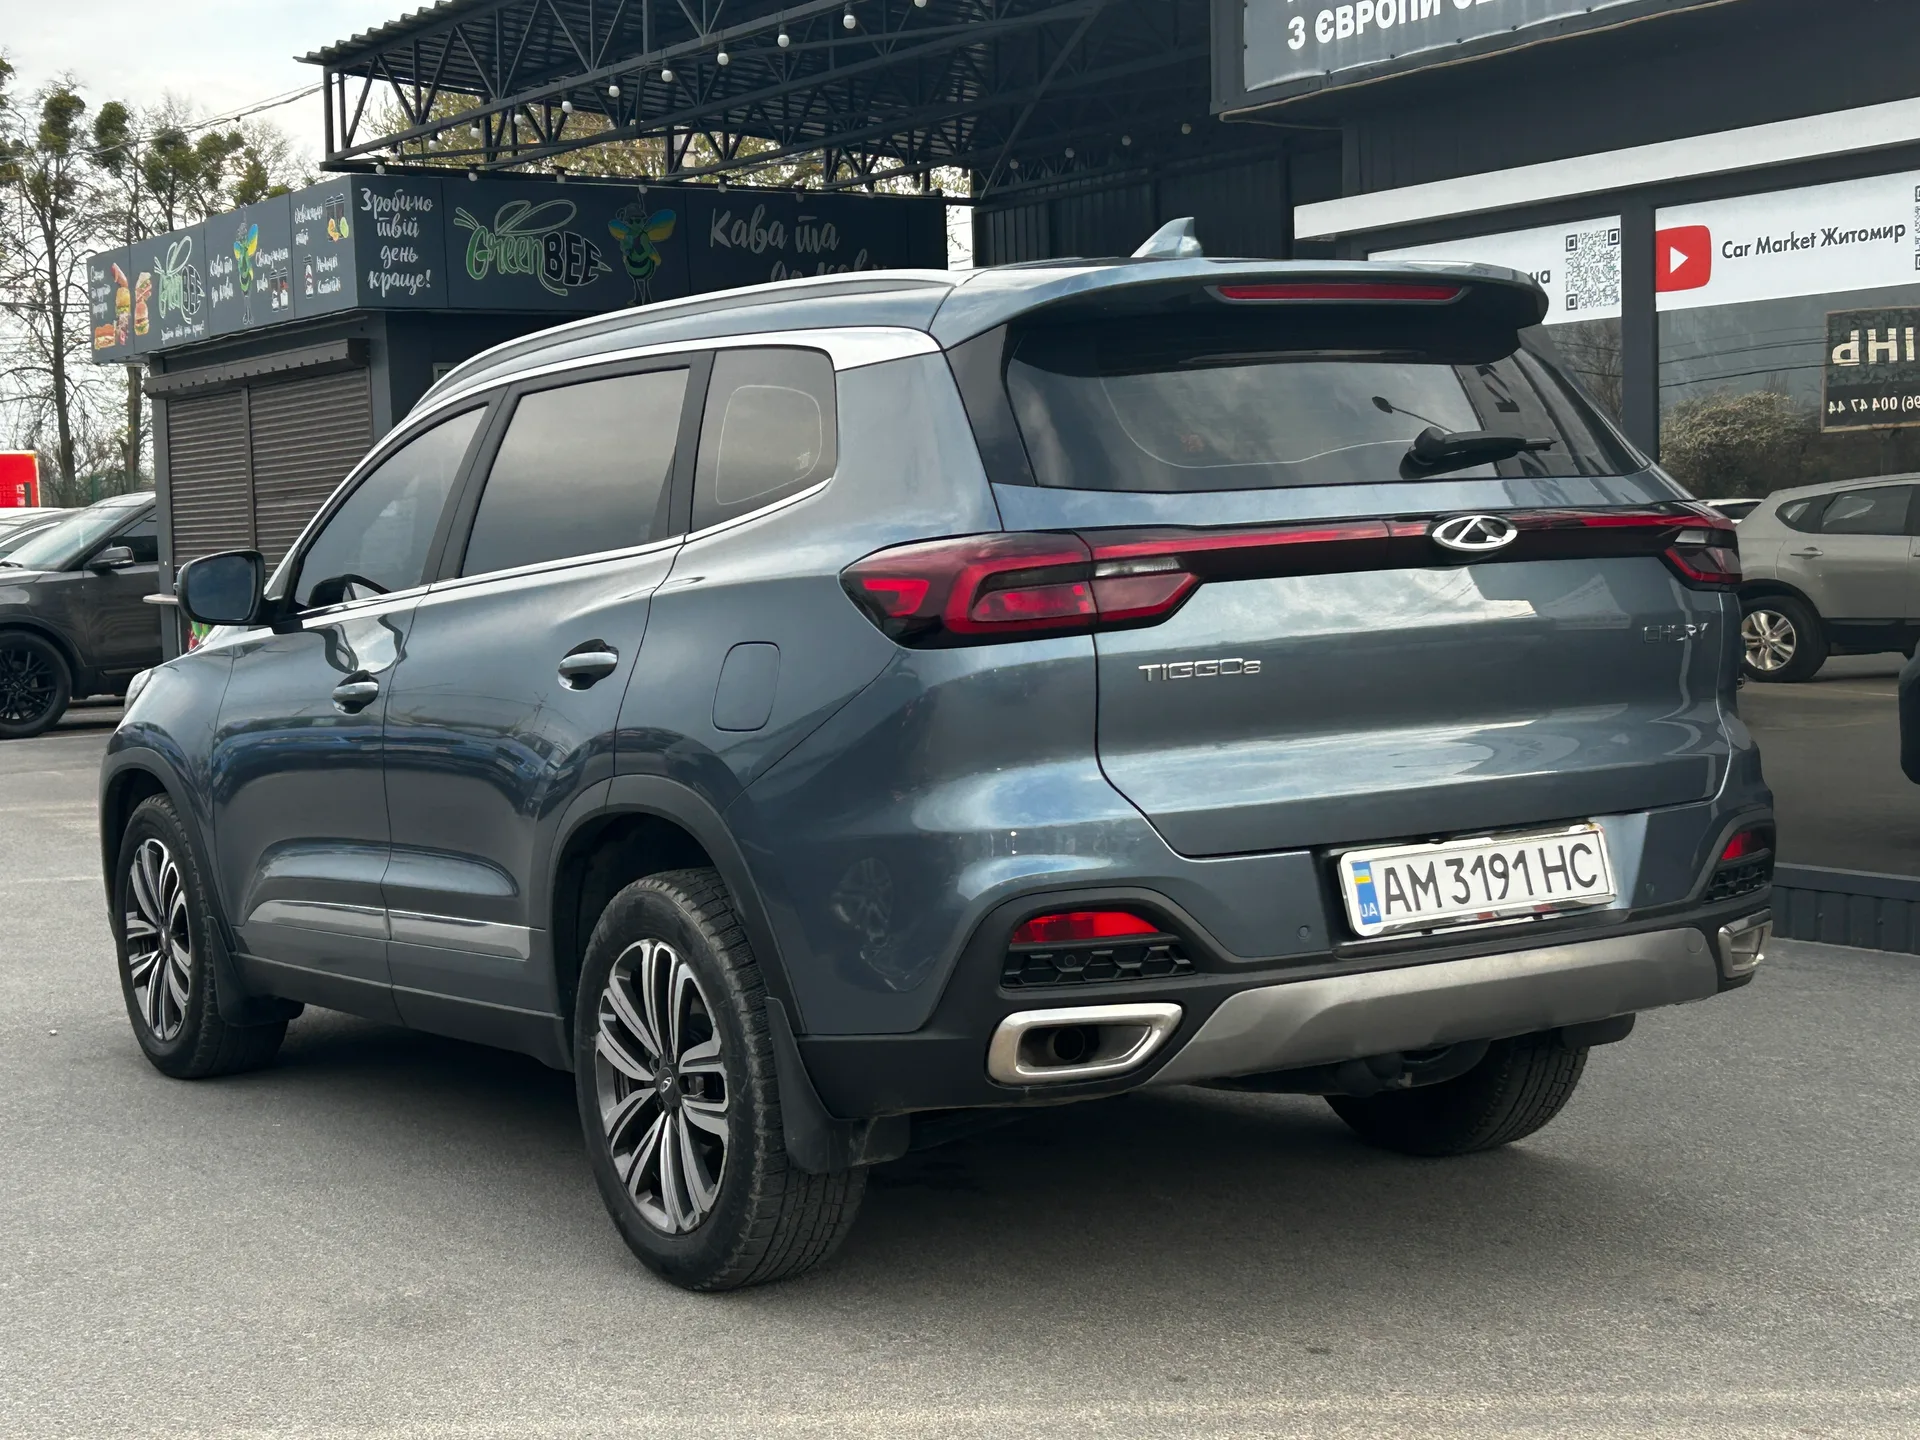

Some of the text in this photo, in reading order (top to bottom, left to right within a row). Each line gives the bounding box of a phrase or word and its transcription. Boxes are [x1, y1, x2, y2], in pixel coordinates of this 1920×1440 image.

[1287, 16, 1306, 50] З
[360, 188, 433, 218] Зробимо
[376, 212, 419, 238] твій
[710, 204, 840, 254] Кава та
[1721, 223, 1906, 259] Car Market Житомир
[380, 245, 418, 269] день
[367, 269, 431, 297] краще!
[1359, 902, 1379, 917] UA
